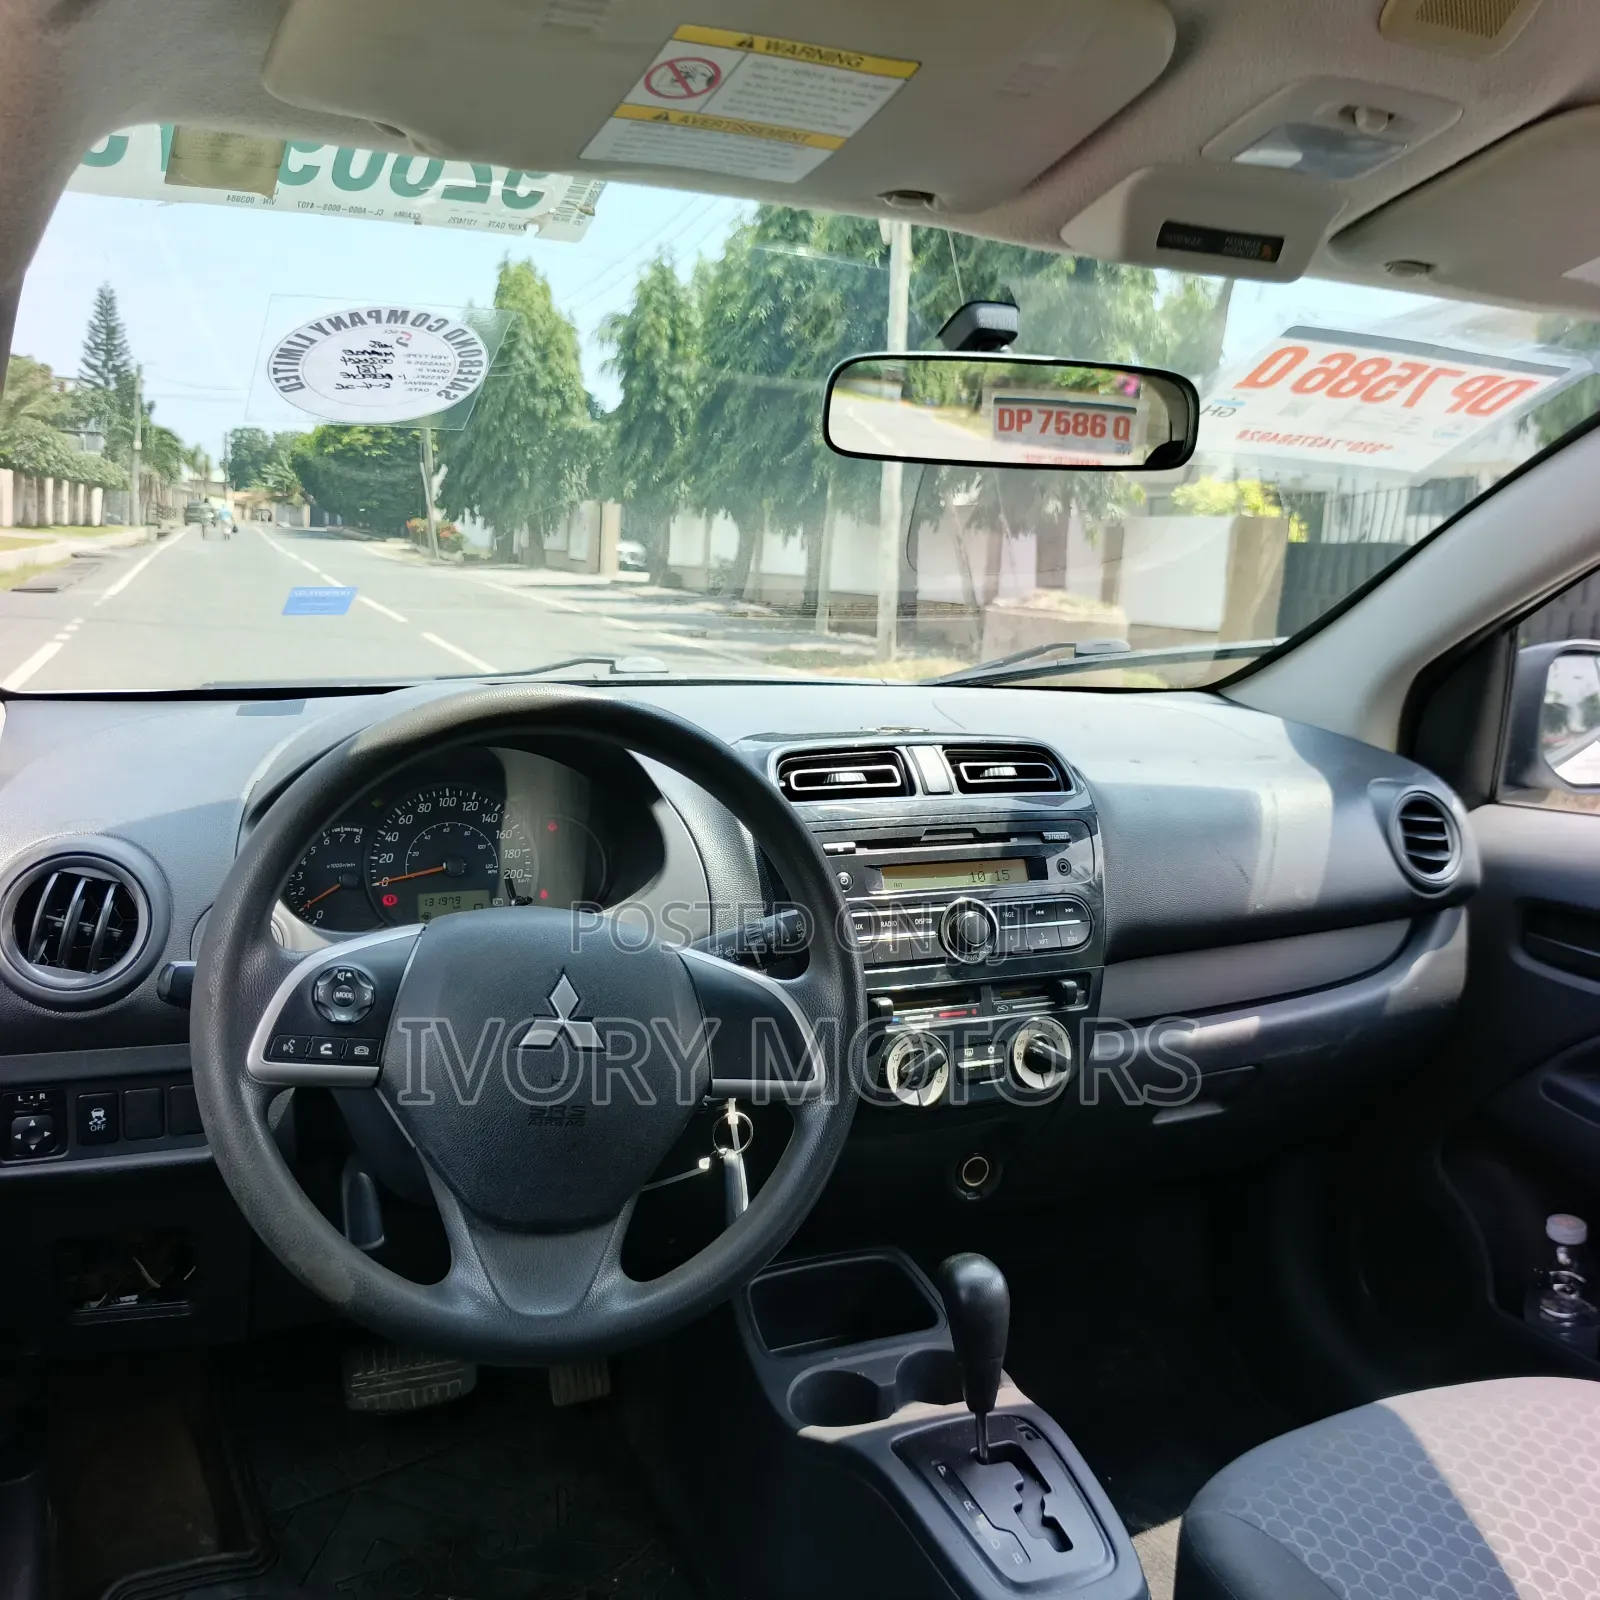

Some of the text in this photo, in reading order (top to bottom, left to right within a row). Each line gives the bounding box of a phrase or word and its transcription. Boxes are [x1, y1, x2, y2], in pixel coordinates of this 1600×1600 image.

[764, 39, 865, 68] WARNING
[997, 407, 1131, 442] DP 7586 Q
[439, 797, 457, 807] 100
[462, 801, 479, 811] 120
[417, 803, 432, 813] 80
[398, 814, 413, 825] 60
[481, 813, 498, 823] 140
[339, 833, 346, 843] 7
[354, 834, 361, 844] 8
[385, 831, 399, 842] 40
[495, 829, 513, 839] 160
[323, 836, 330, 845] 6
[310, 846, 316, 855] 5
[504, 848, 521, 859] 180
[301, 857, 307, 866] 4
[379, 853, 394, 863] 20
[296, 871, 304, 881] 3
[503, 869, 523, 879] 200
[298, 886, 305, 896] 2
[316, 910, 323, 919] 0
[880, 920, 898, 928] RADIO
[335, 991, 354, 999] MODE
[1038, 1023, 1043, 1031] 2
[90, 1124, 106, 1132] OFF
[937, 1465, 947, 1478] P
[963, 1500, 975, 1511] R
[991, 1539, 1001, 1550] D
[1012, 1552, 1023, 1565] B
